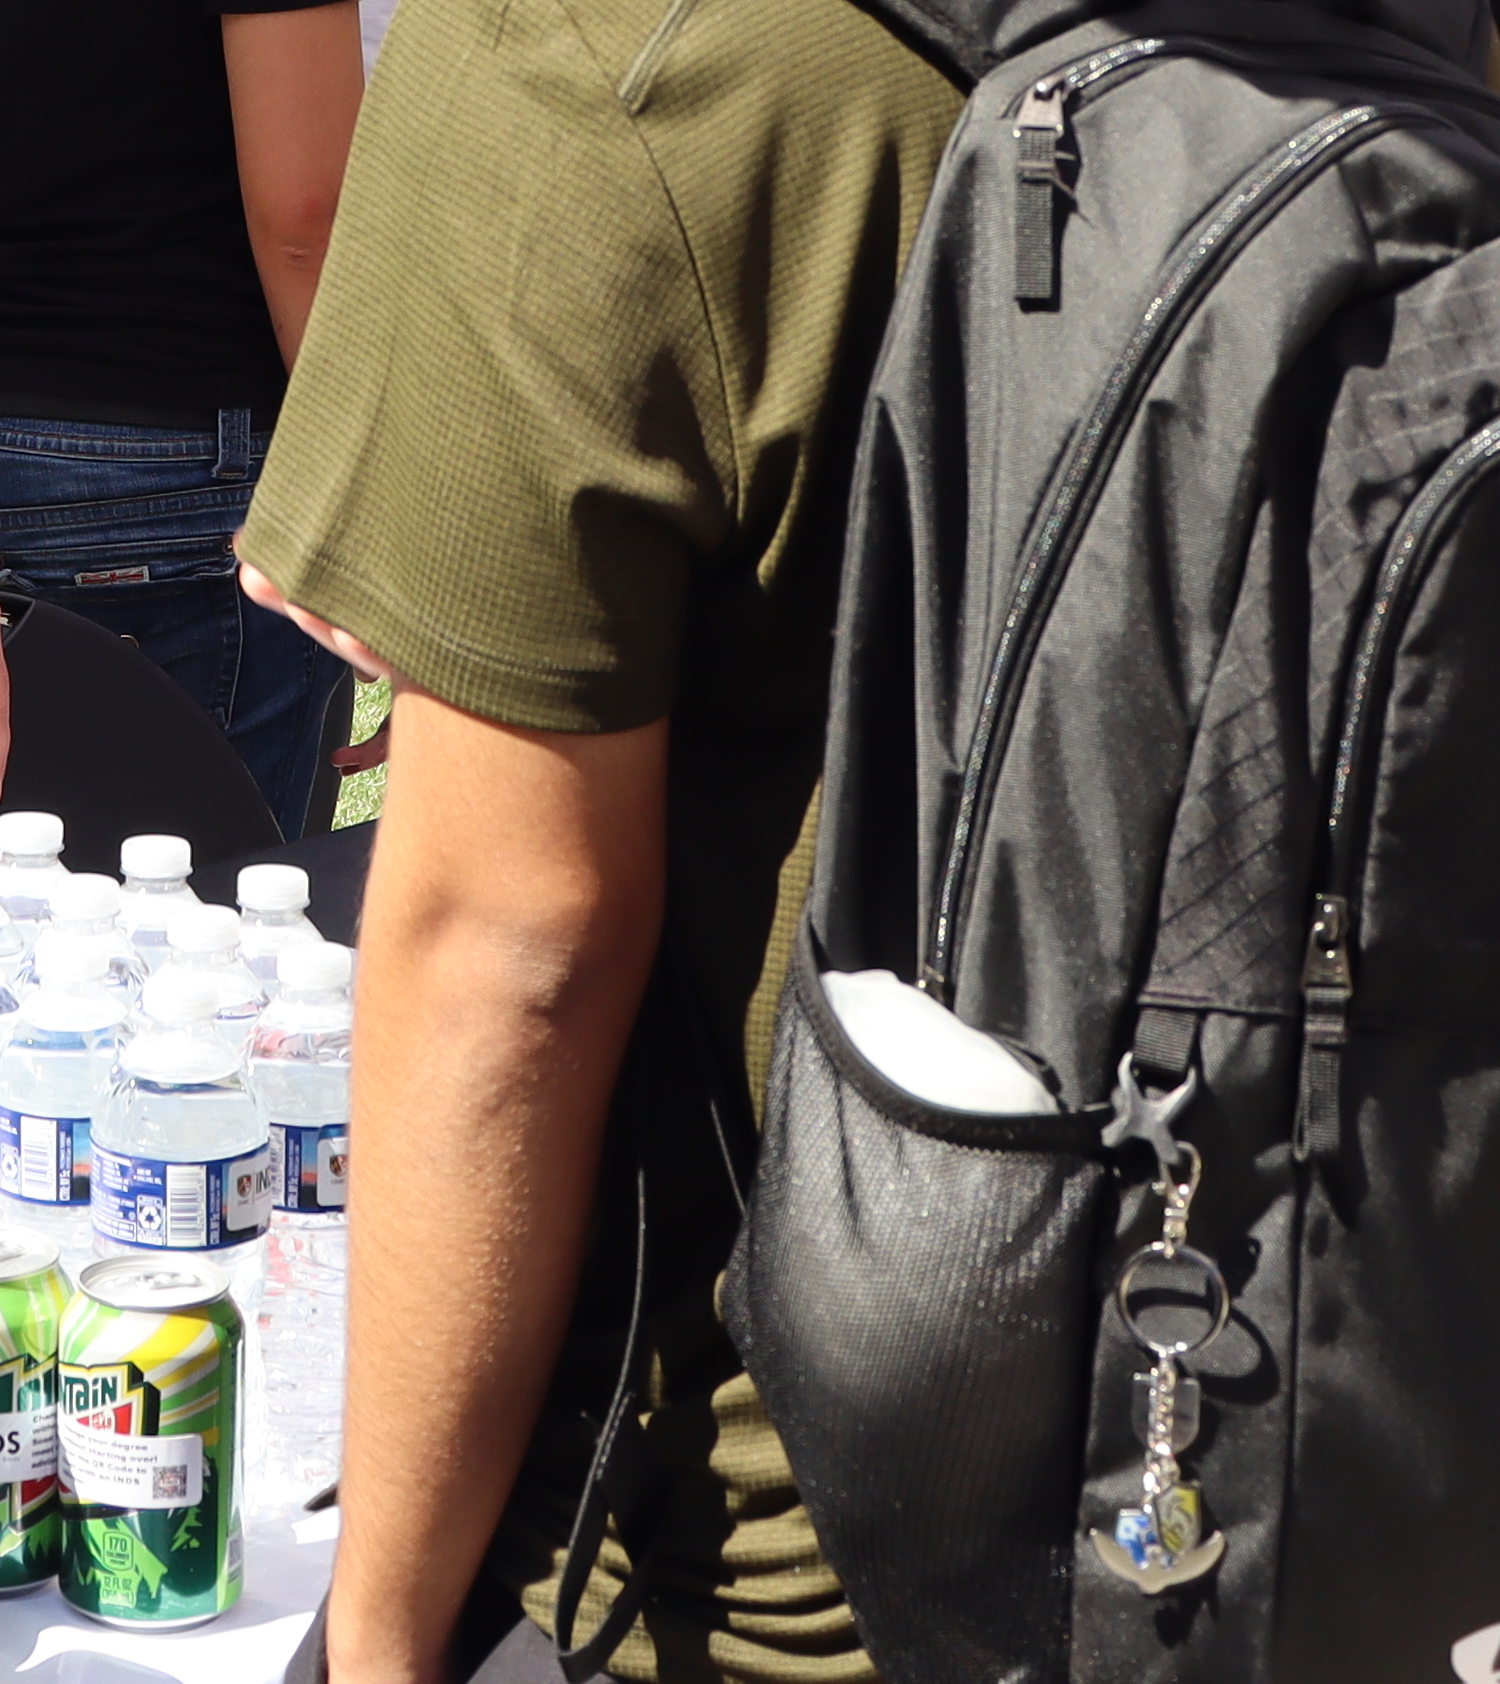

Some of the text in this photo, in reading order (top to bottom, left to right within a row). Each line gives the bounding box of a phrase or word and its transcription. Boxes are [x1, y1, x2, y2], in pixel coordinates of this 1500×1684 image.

[111, 1440, 149, 1452] degree
[136, 1466, 148, 1474] to
[113, 1475, 140, 1485] INDS
[109, 1536, 127, 1553] 170
